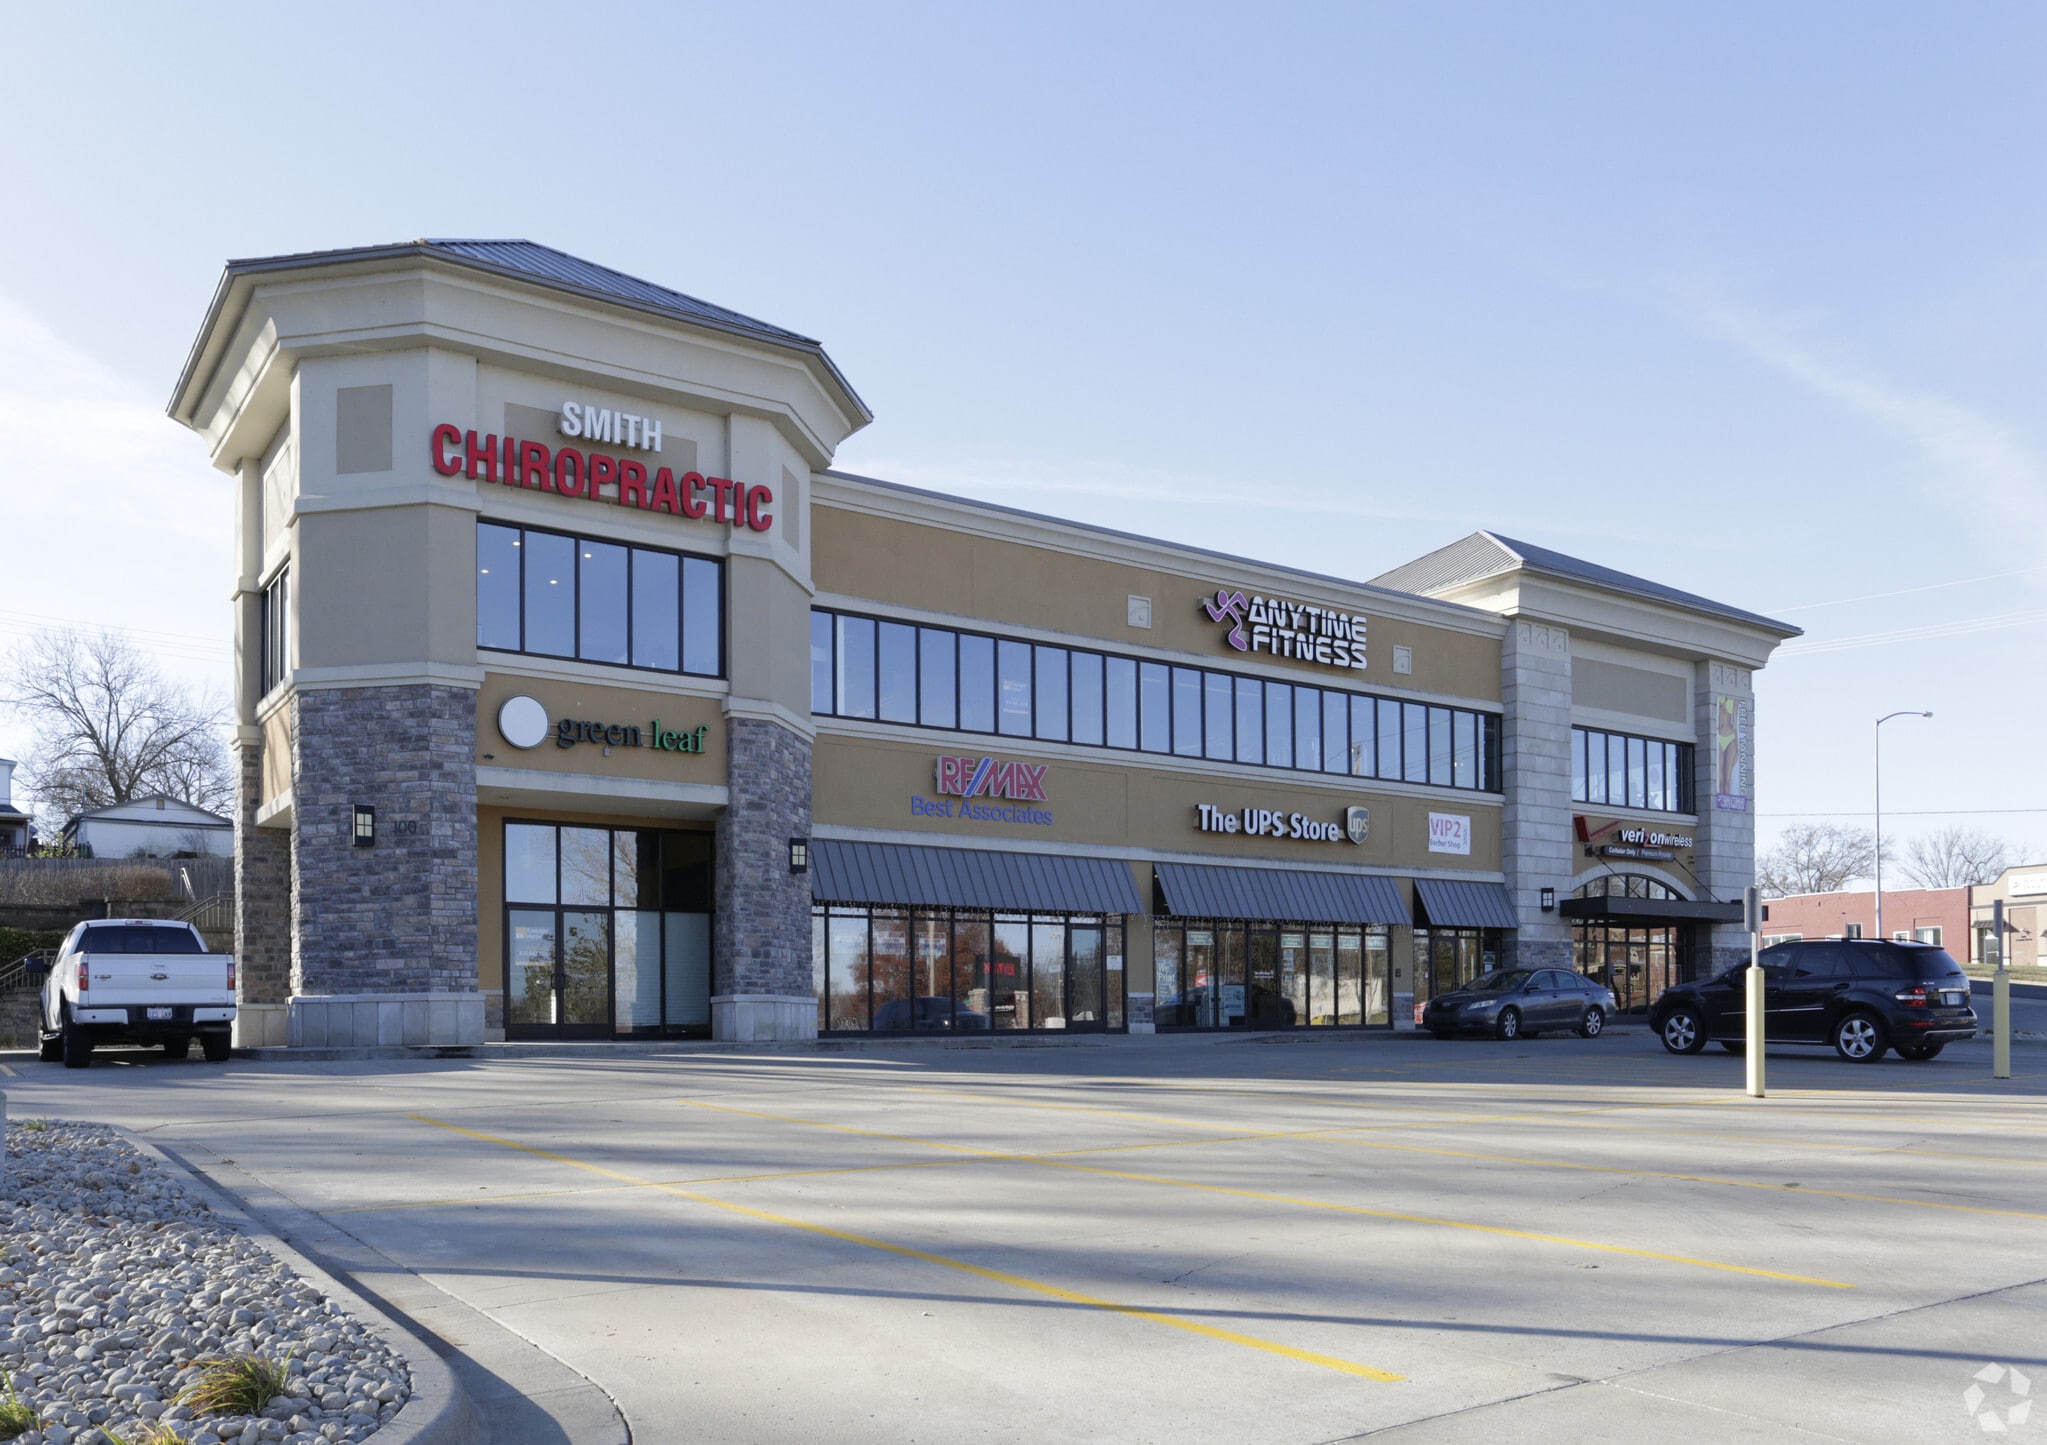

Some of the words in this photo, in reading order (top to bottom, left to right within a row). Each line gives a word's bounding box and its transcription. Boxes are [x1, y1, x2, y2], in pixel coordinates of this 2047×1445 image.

[559, 401, 662, 452] SMITH
[432, 423, 774, 532] CHIROPRACTIC
[1248, 595, 1368, 643] ANYTIME
[1252, 625, 1368, 670] FITNESS
[556, 718, 643, 748] green
[652, 719, 710, 753] leaf
[937, 755, 1048, 801] RE/MAX
[911, 795, 953, 818] Best
[959, 800, 1054, 825] Associates
[1197, 804, 1236, 833] The
[1241, 808, 1284, 837] UPS
[1290, 813, 1339, 842] Store
[1350, 817, 1368, 841] ups
[1430, 818, 1461, 838] VIP2
[1448, 840, 1461, 850] Shop
[1626, 848, 1636, 856] Only
[1158, 962, 1170, 972] We
[1158, 972, 1176, 983] Print
